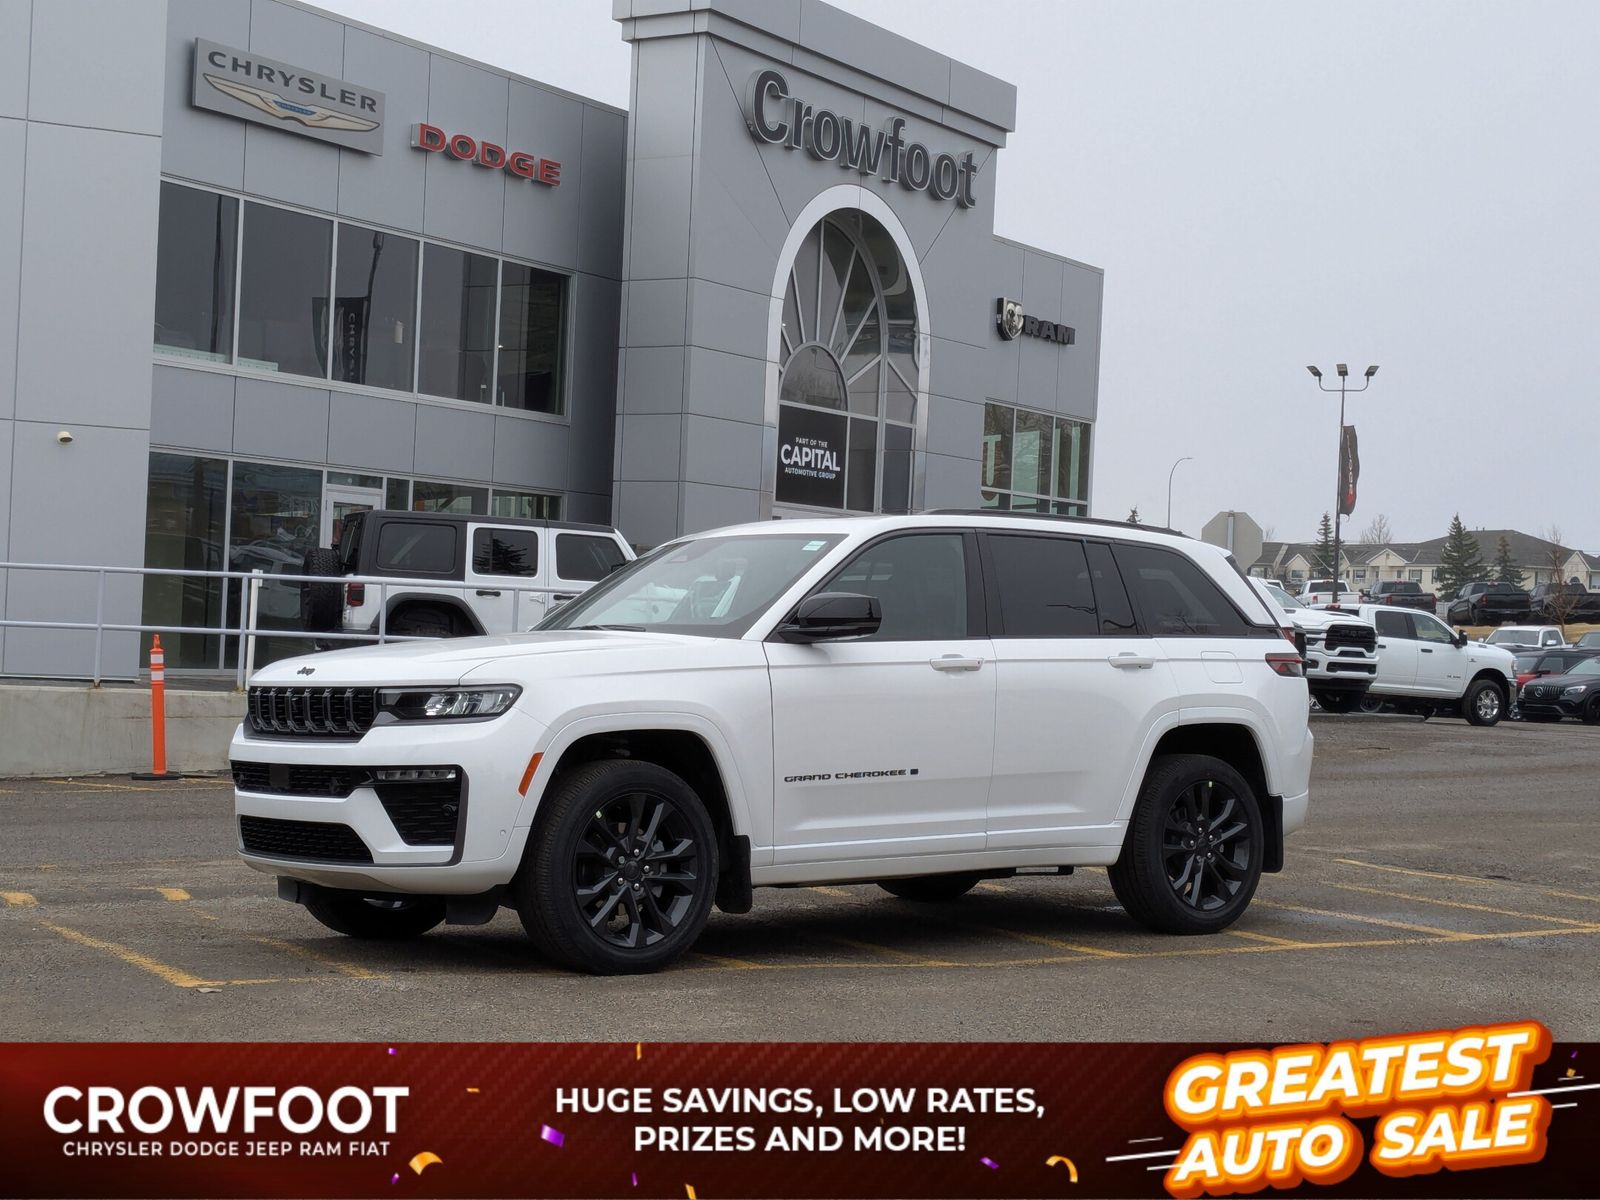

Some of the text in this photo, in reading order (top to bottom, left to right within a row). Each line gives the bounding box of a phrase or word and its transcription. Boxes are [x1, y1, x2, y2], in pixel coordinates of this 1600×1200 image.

[208, 51, 377, 113] CHRYSLER
[748, 69, 978, 209] Crowfoot
[417, 122, 561, 187] DODGE
[1023, 314, 1075, 345] RAM
[796, 437, 809, 445] PART
[781, 444, 841, 471] CAPITAL
[785, 467, 836, 480] AUTOMOTIVE GROUP
[784, 769, 907, 783] GRAND CHEROKEE
